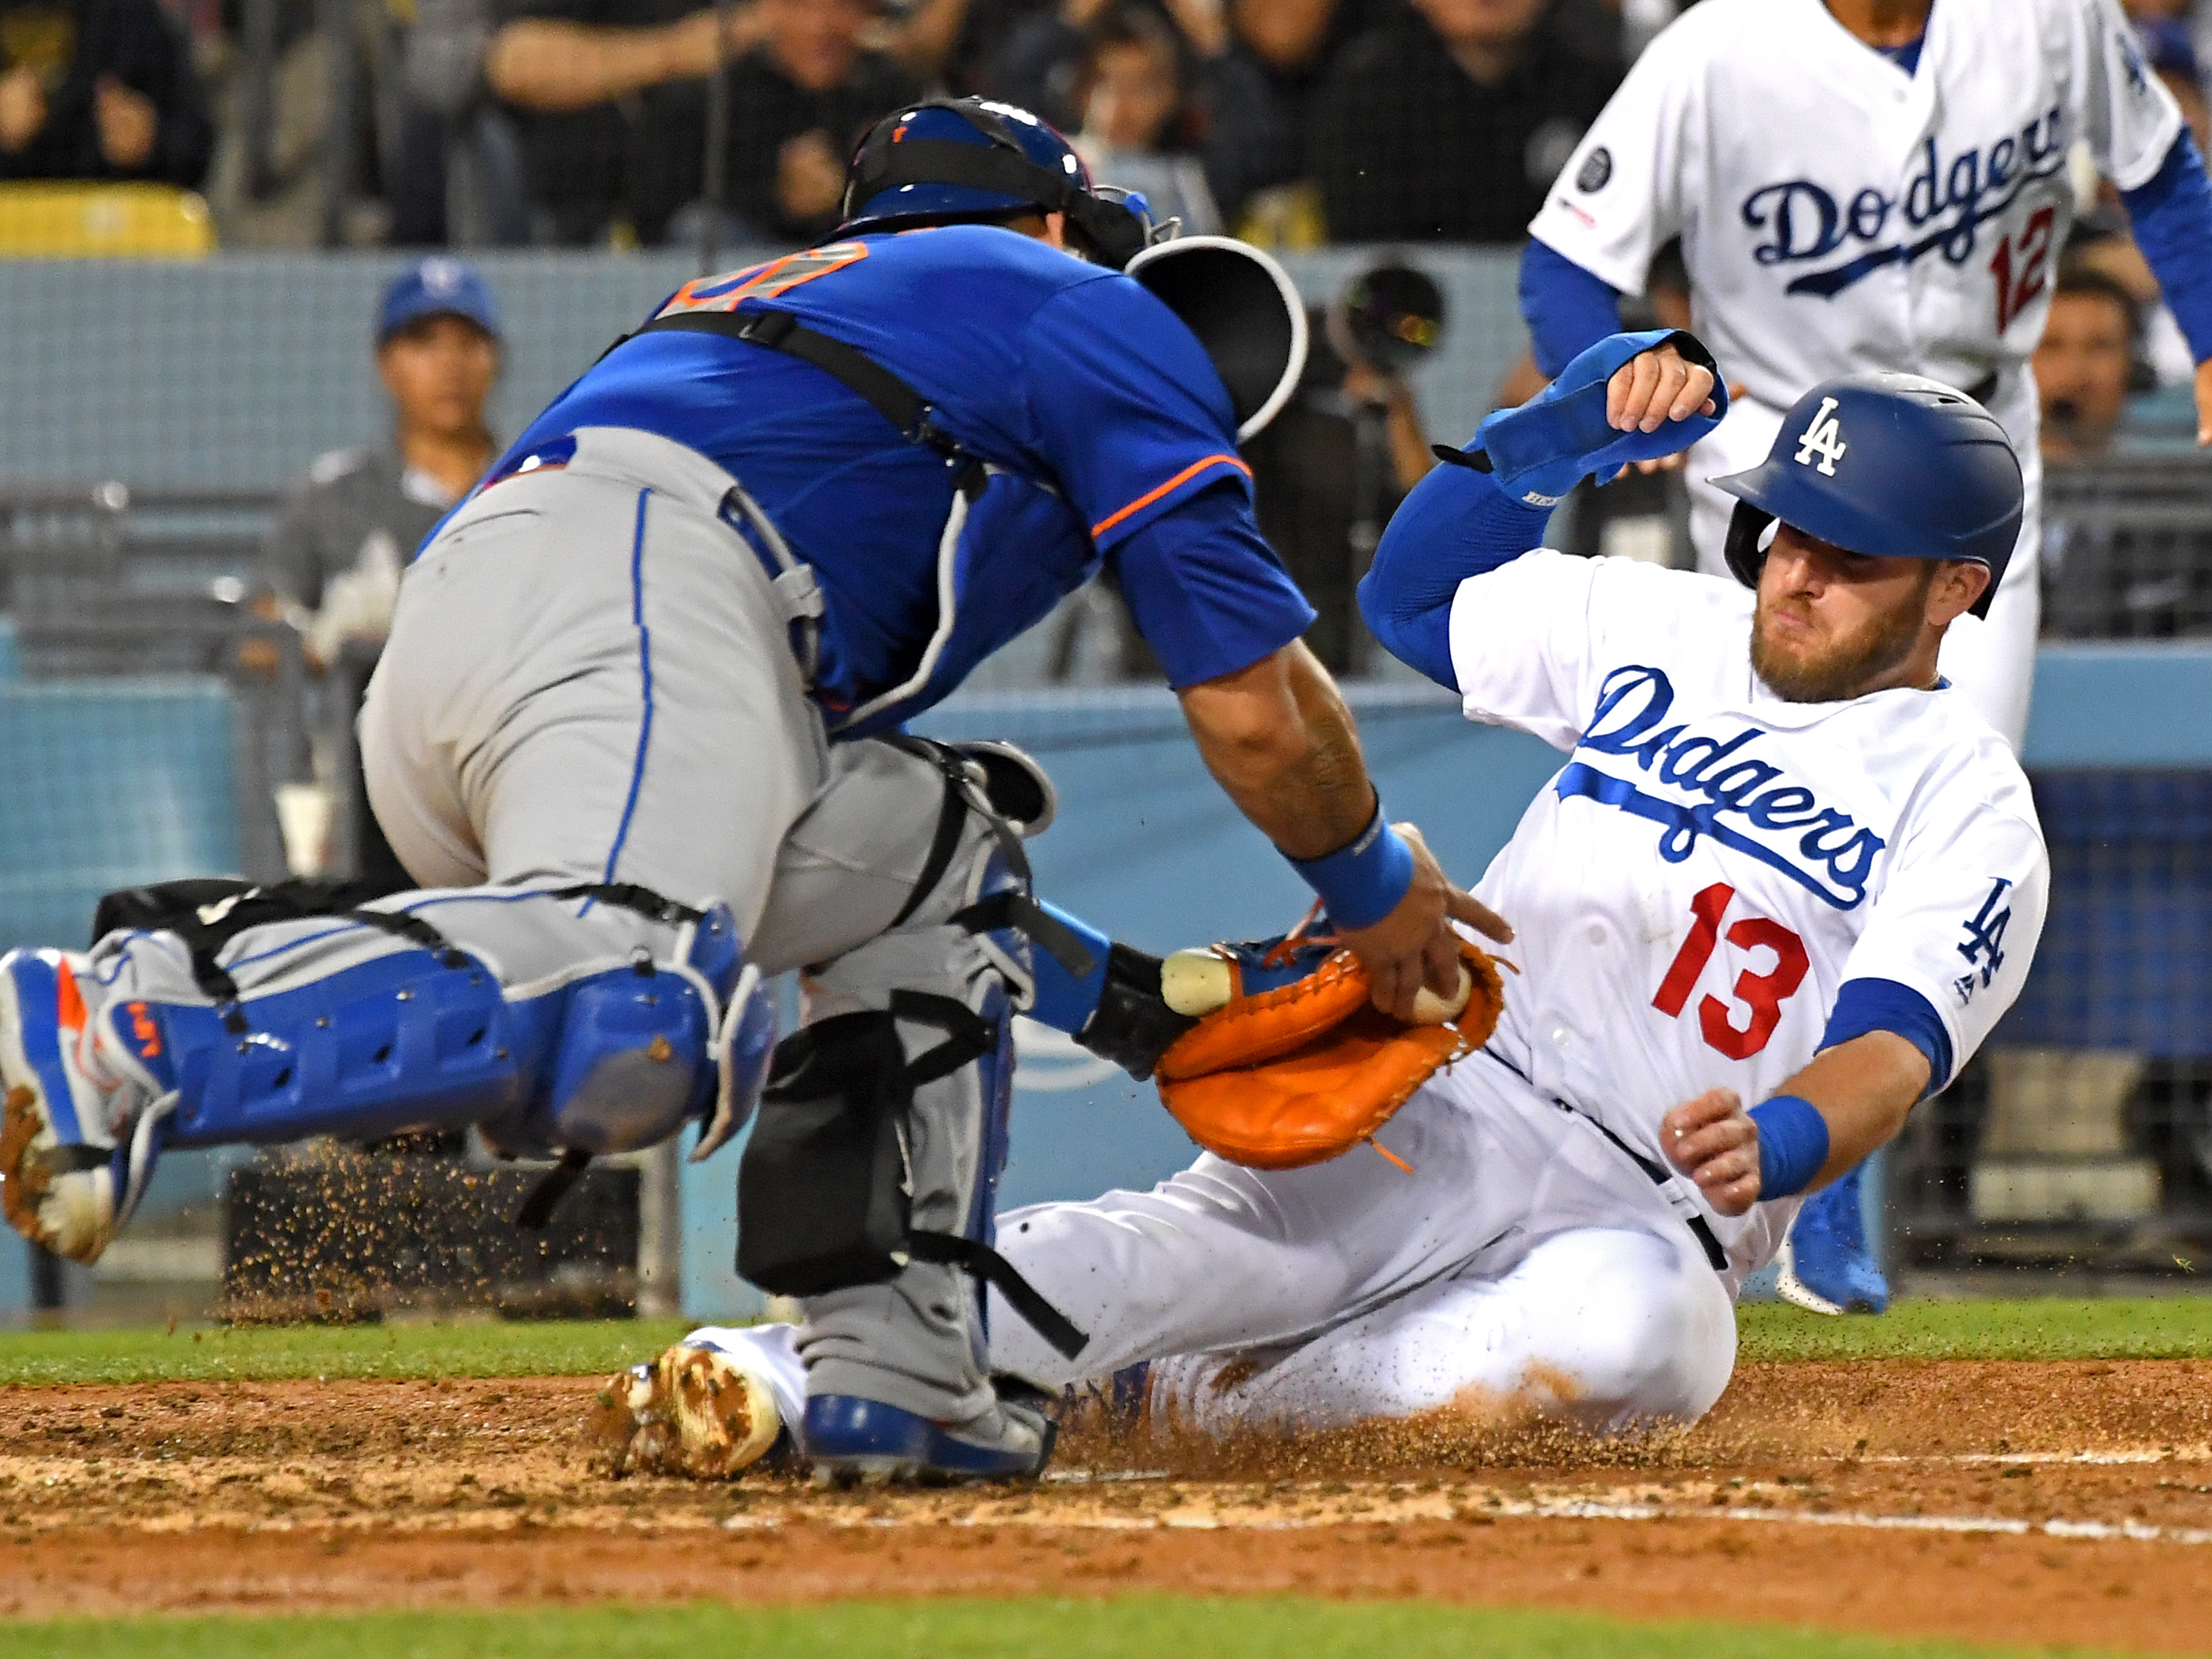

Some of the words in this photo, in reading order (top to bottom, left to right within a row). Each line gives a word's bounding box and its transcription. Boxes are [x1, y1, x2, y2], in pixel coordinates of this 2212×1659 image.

[1988, 205, 2054, 337] 12
[1794, 396, 1846, 477] LA
[1651, 882, 1810, 1061] 13
[1956, 876, 2012, 989] LA
